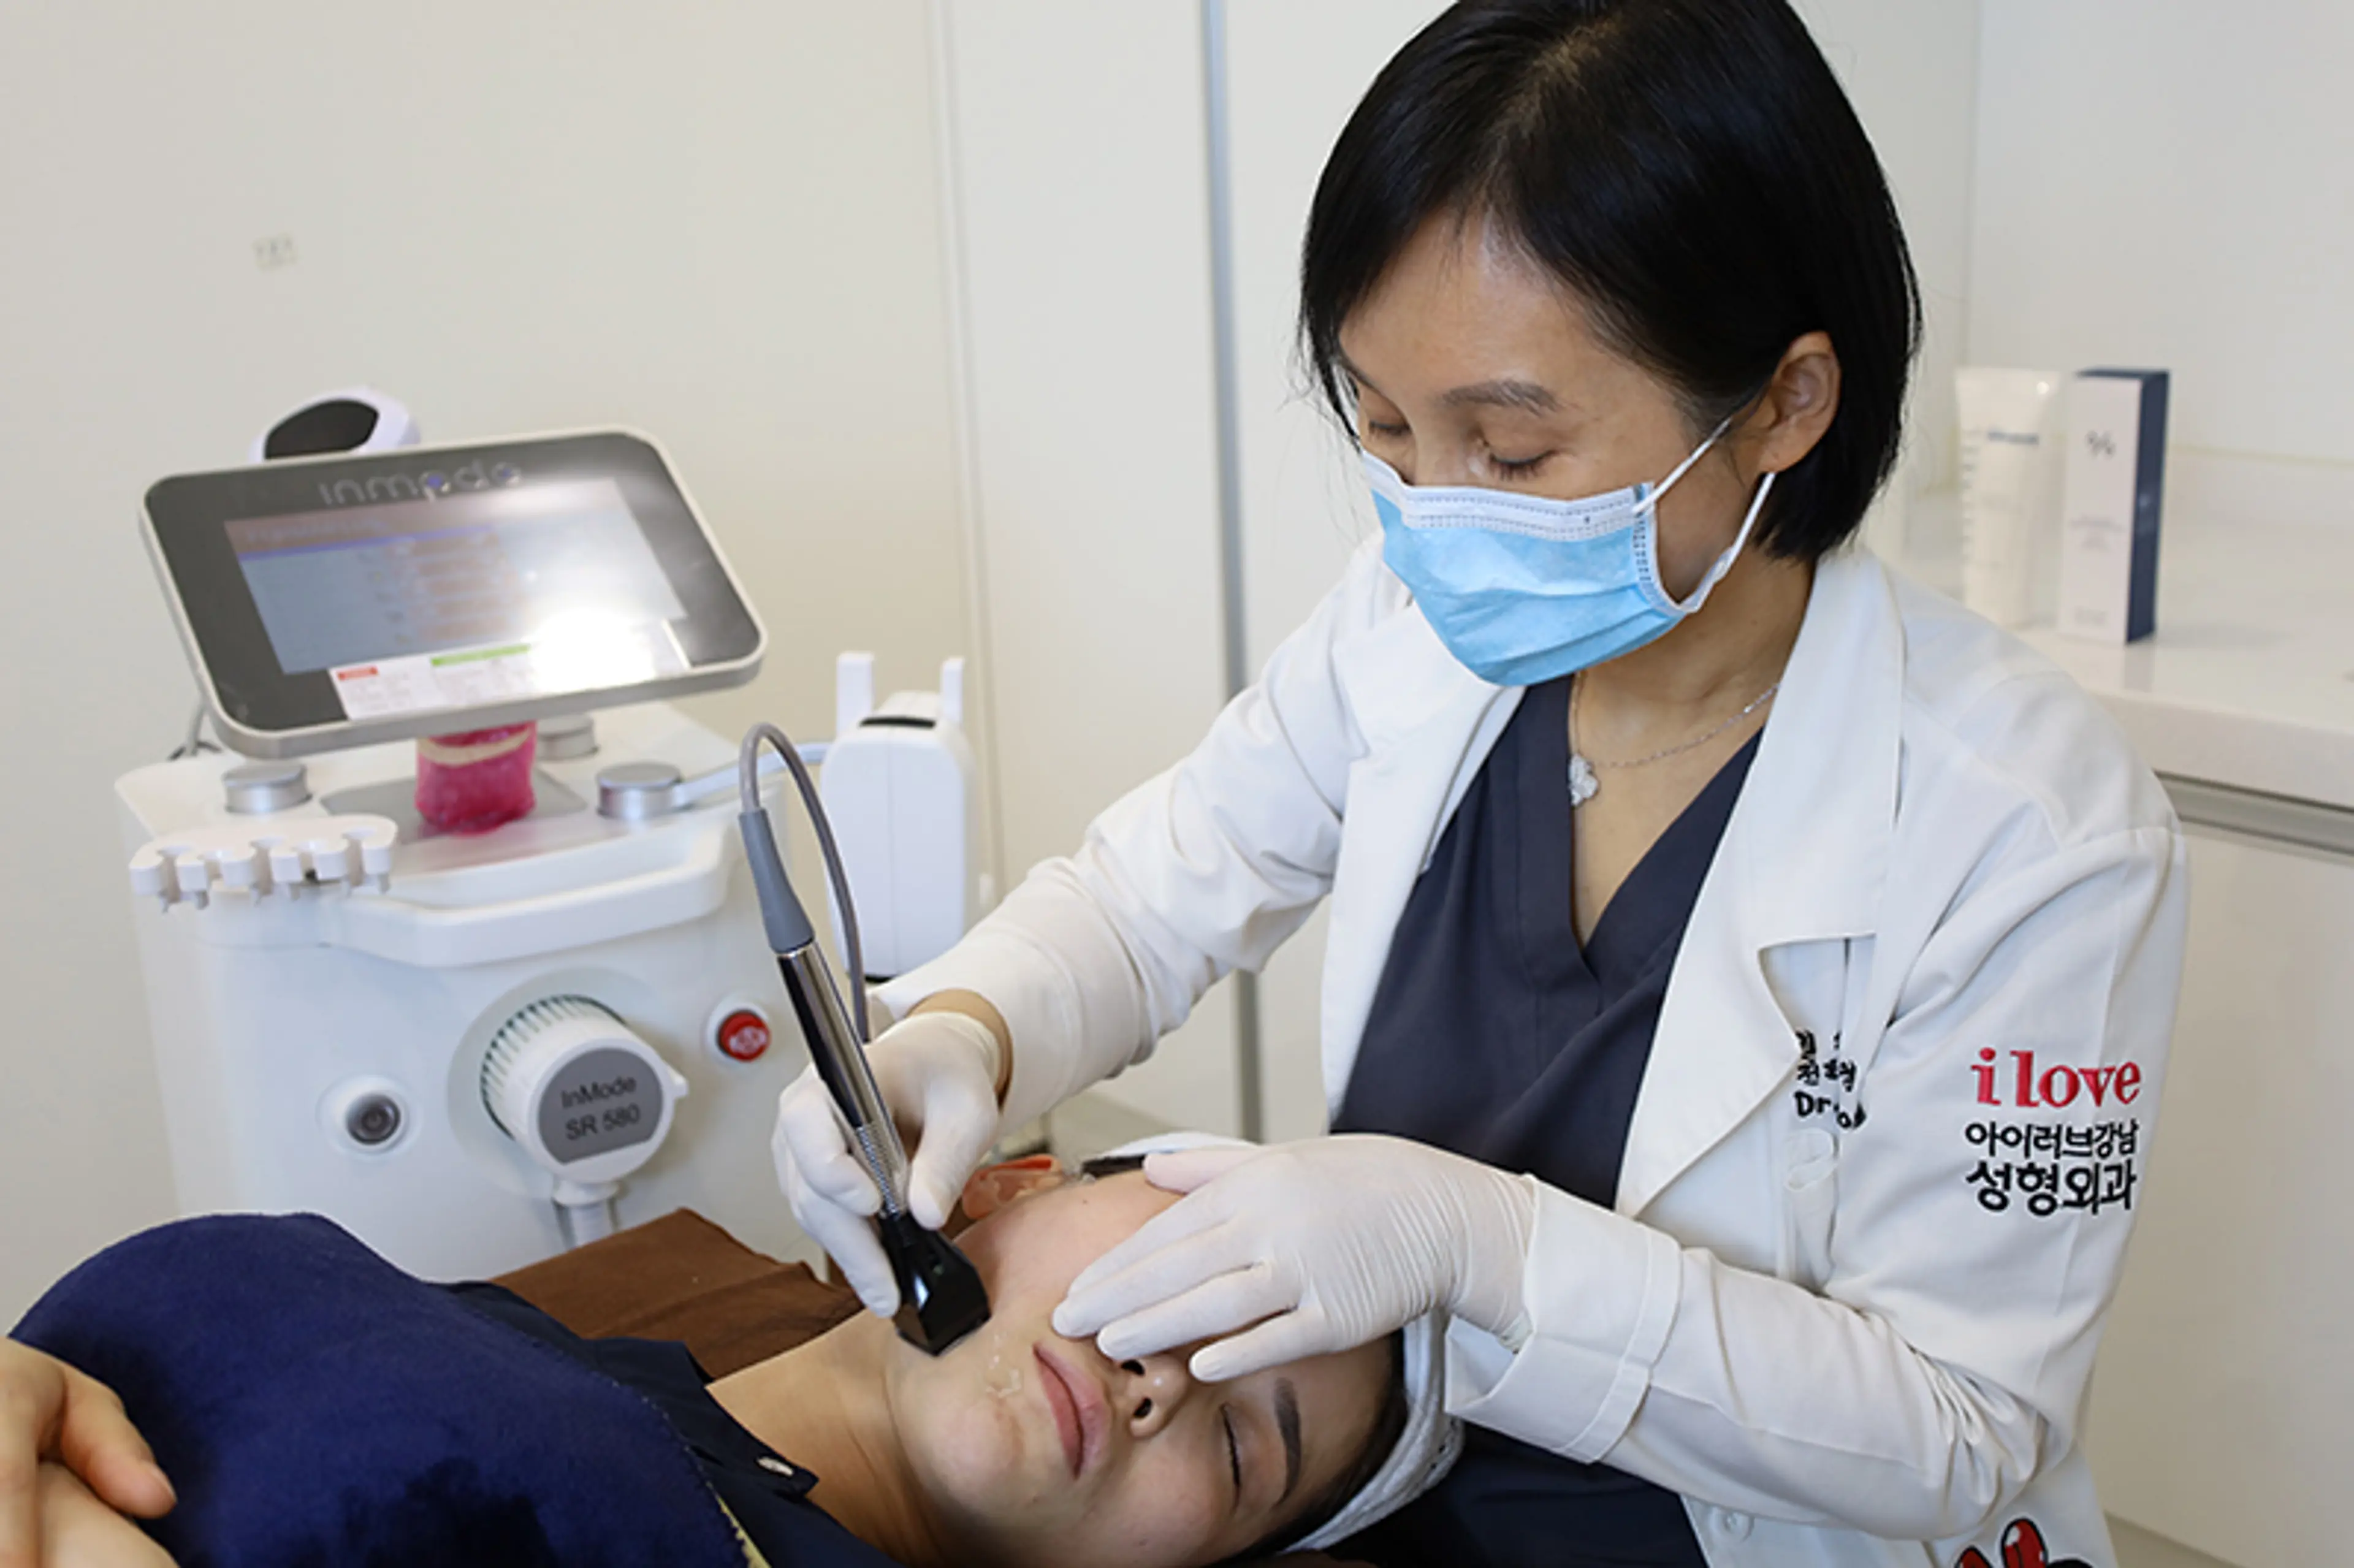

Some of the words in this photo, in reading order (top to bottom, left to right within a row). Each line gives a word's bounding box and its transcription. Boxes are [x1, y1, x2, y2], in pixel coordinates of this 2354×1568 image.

[561, 1076, 638, 1110] InMode
[1970, 1046, 2002, 1106] i
[2009, 1049, 2141, 1108] love
[565, 1113, 598, 1141] SR
[603, 1102, 642, 1132] 580
[1965, 1118, 2139, 1160] 아이러브강남
[1965, 1158, 2138, 1216] 성형외과
